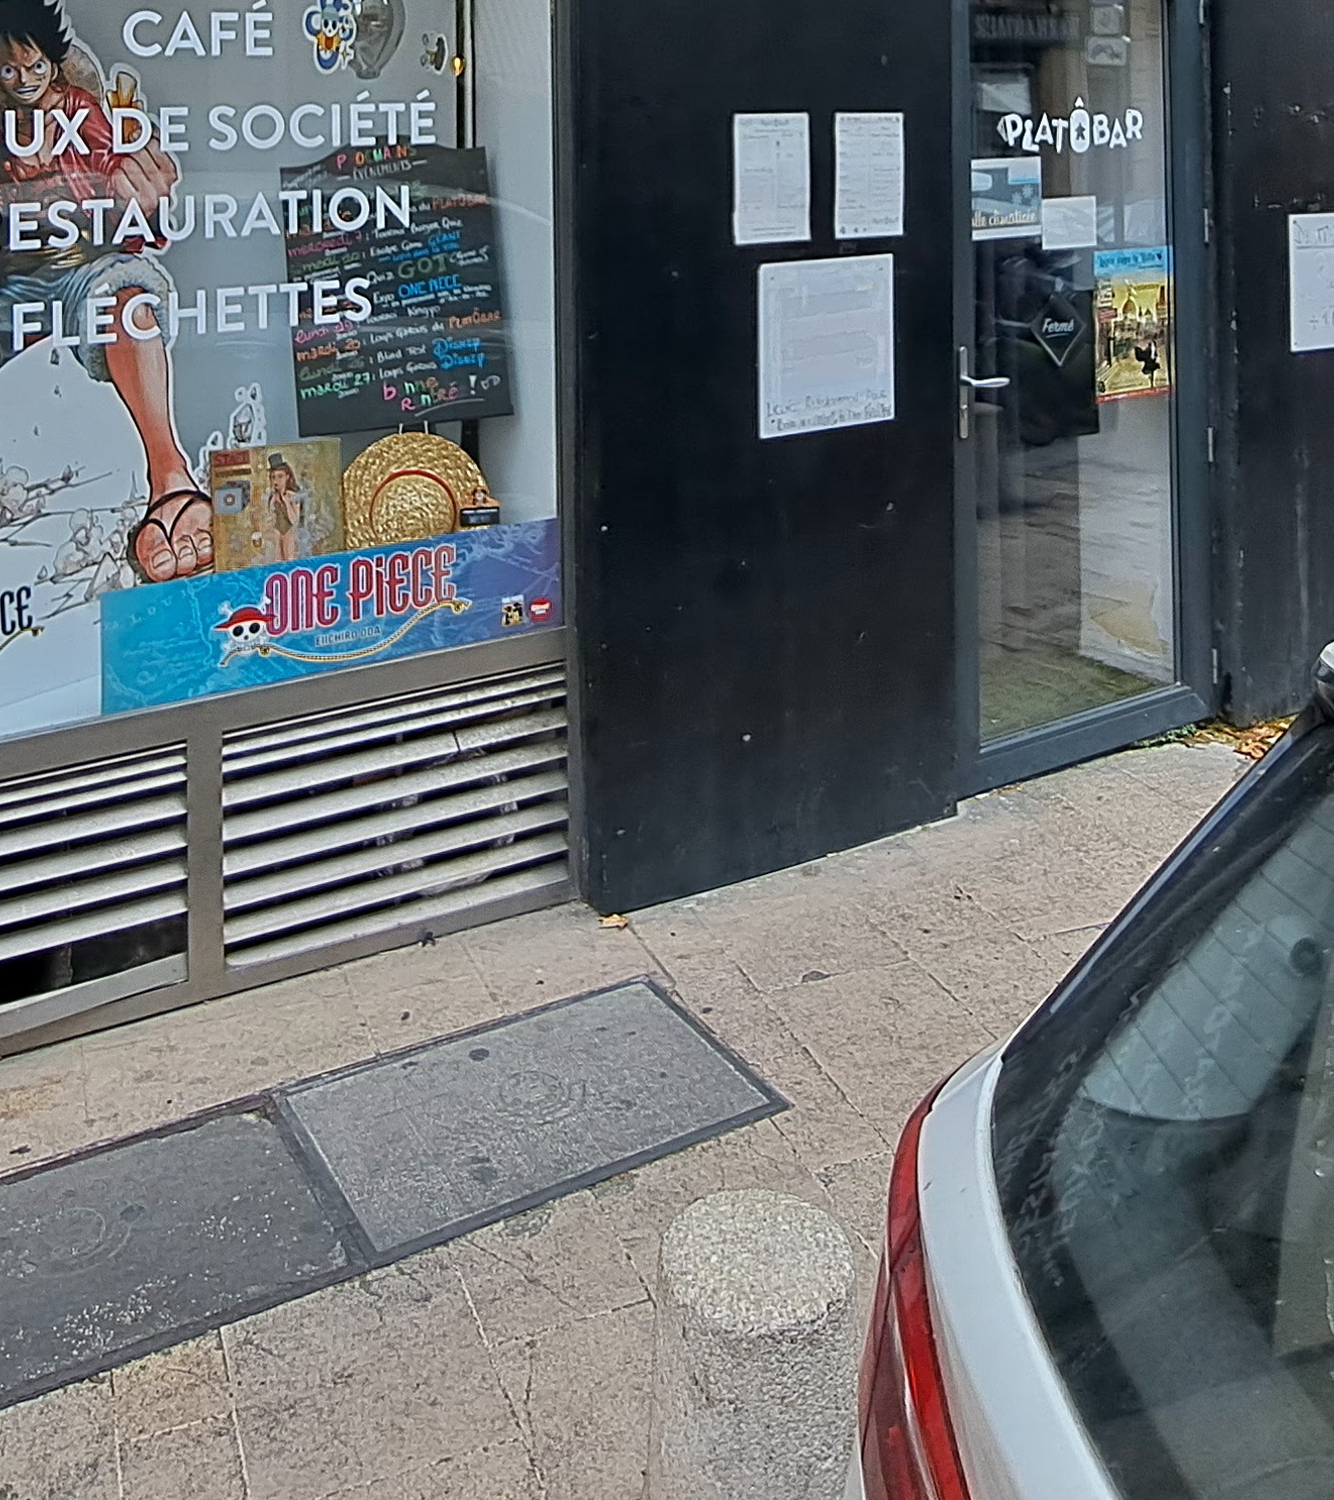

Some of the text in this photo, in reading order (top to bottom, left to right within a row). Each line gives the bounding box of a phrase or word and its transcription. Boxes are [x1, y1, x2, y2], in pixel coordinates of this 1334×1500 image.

[111, 106, 190, 156] DE
[207, 89, 438, 152] SOCIÉTÉ
[996, 97, 1144, 154] PLATÔBAR
[11, 276, 374, 352] FLÉCHETTES
[1042, 318, 1075, 333] Fermé
[266, 563, 340, 637] ONE
